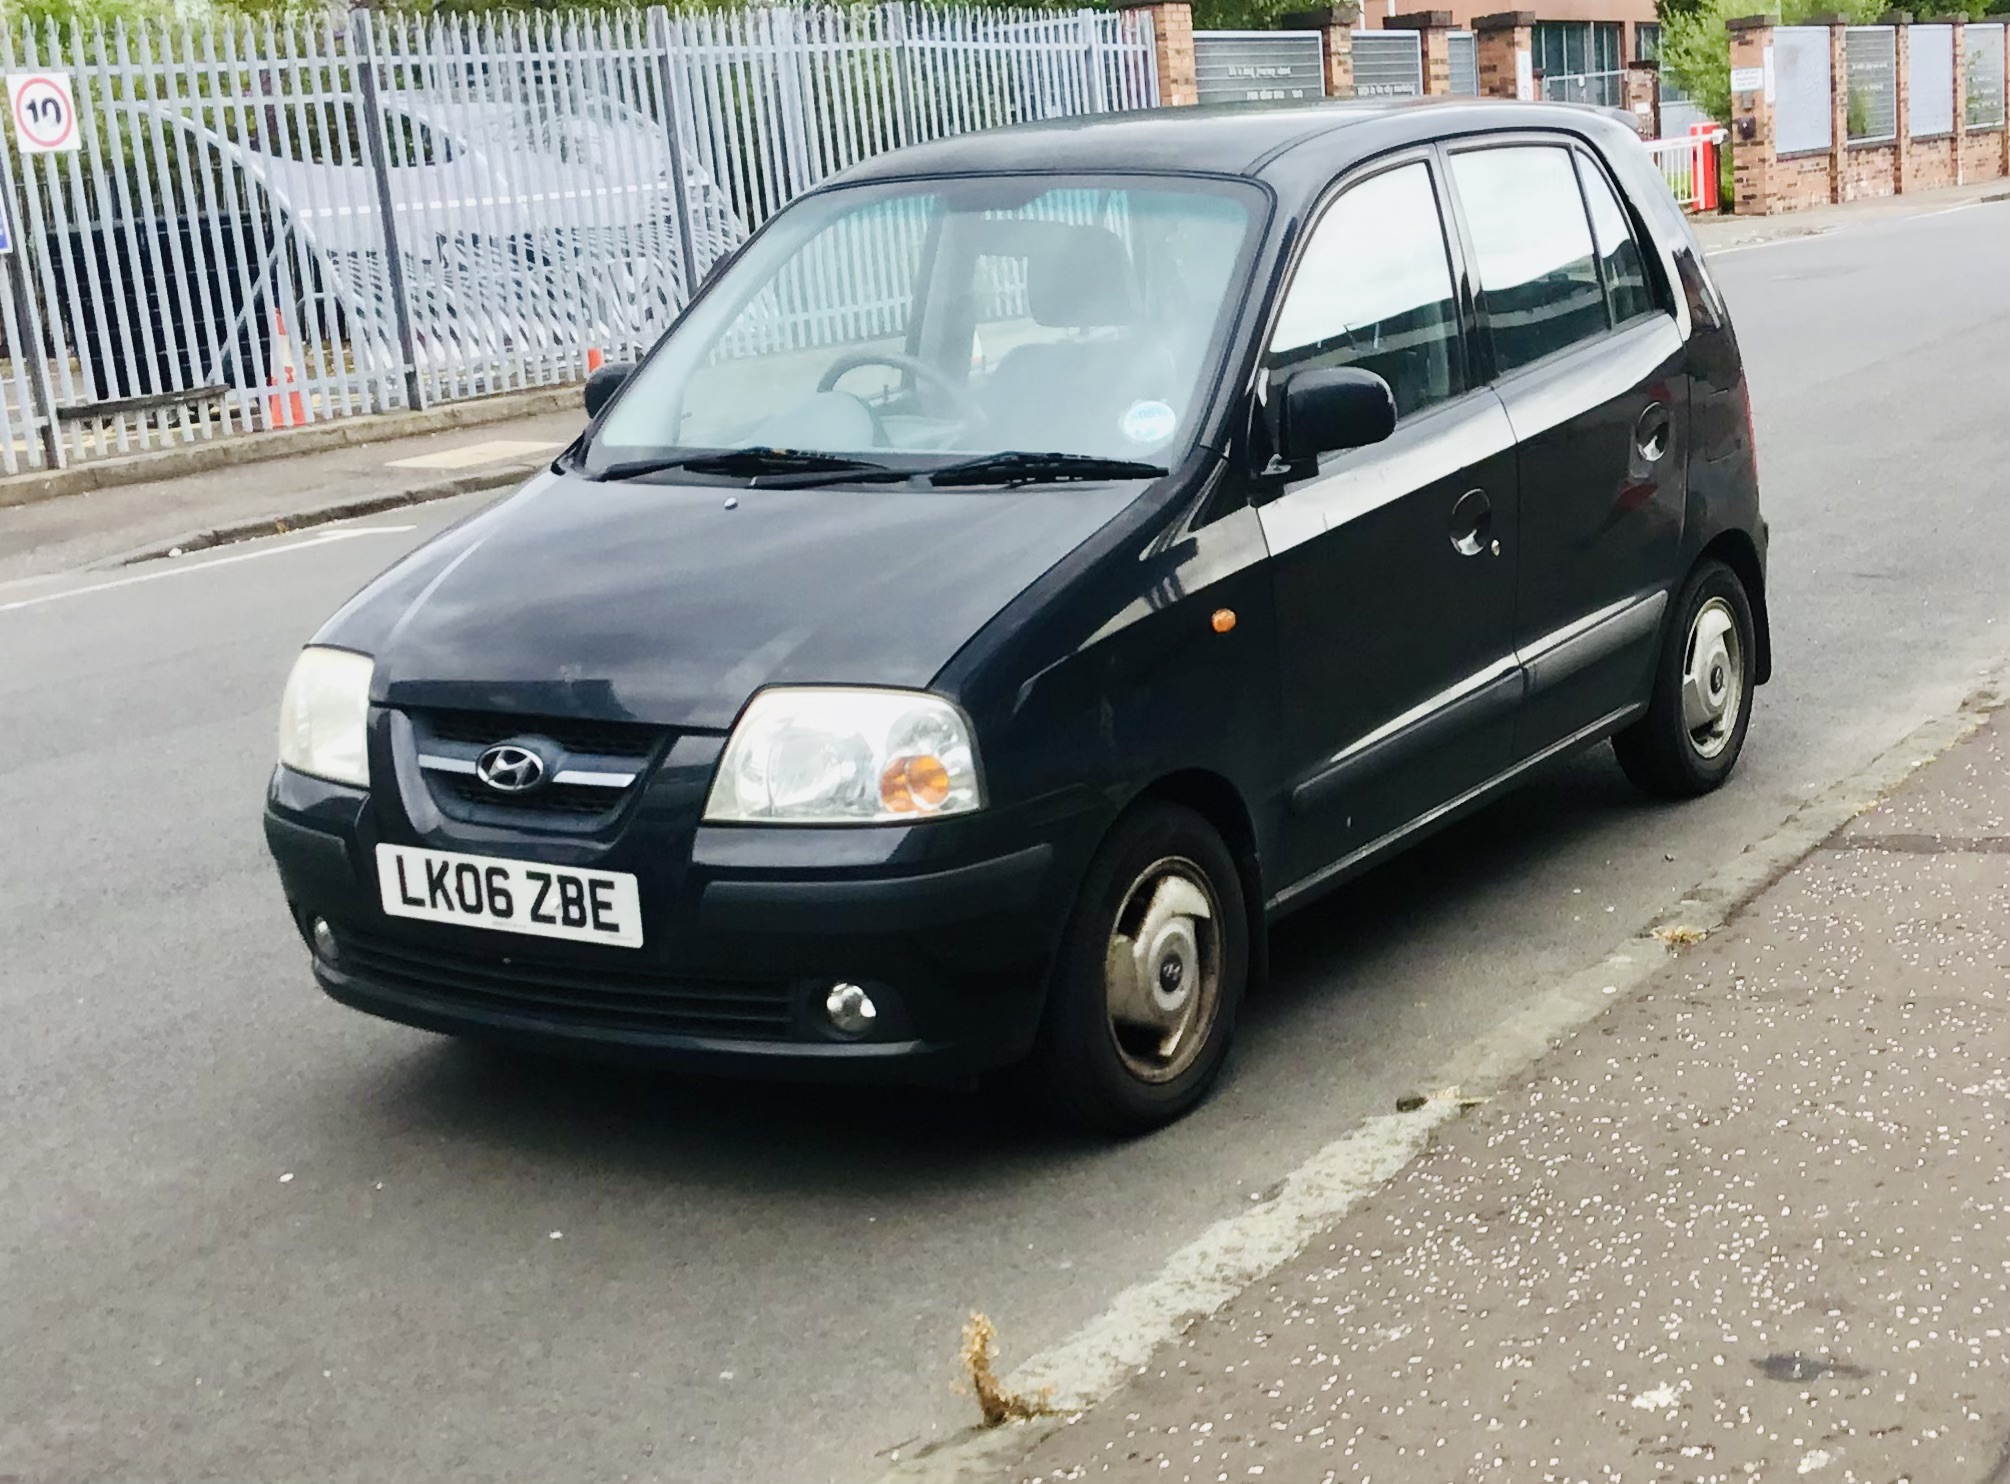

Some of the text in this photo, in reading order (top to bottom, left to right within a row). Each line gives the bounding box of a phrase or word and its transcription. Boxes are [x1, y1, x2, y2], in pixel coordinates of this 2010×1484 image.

[26, 97, 62, 125] 10
[396, 855, 620, 932] LK06 ZBE
